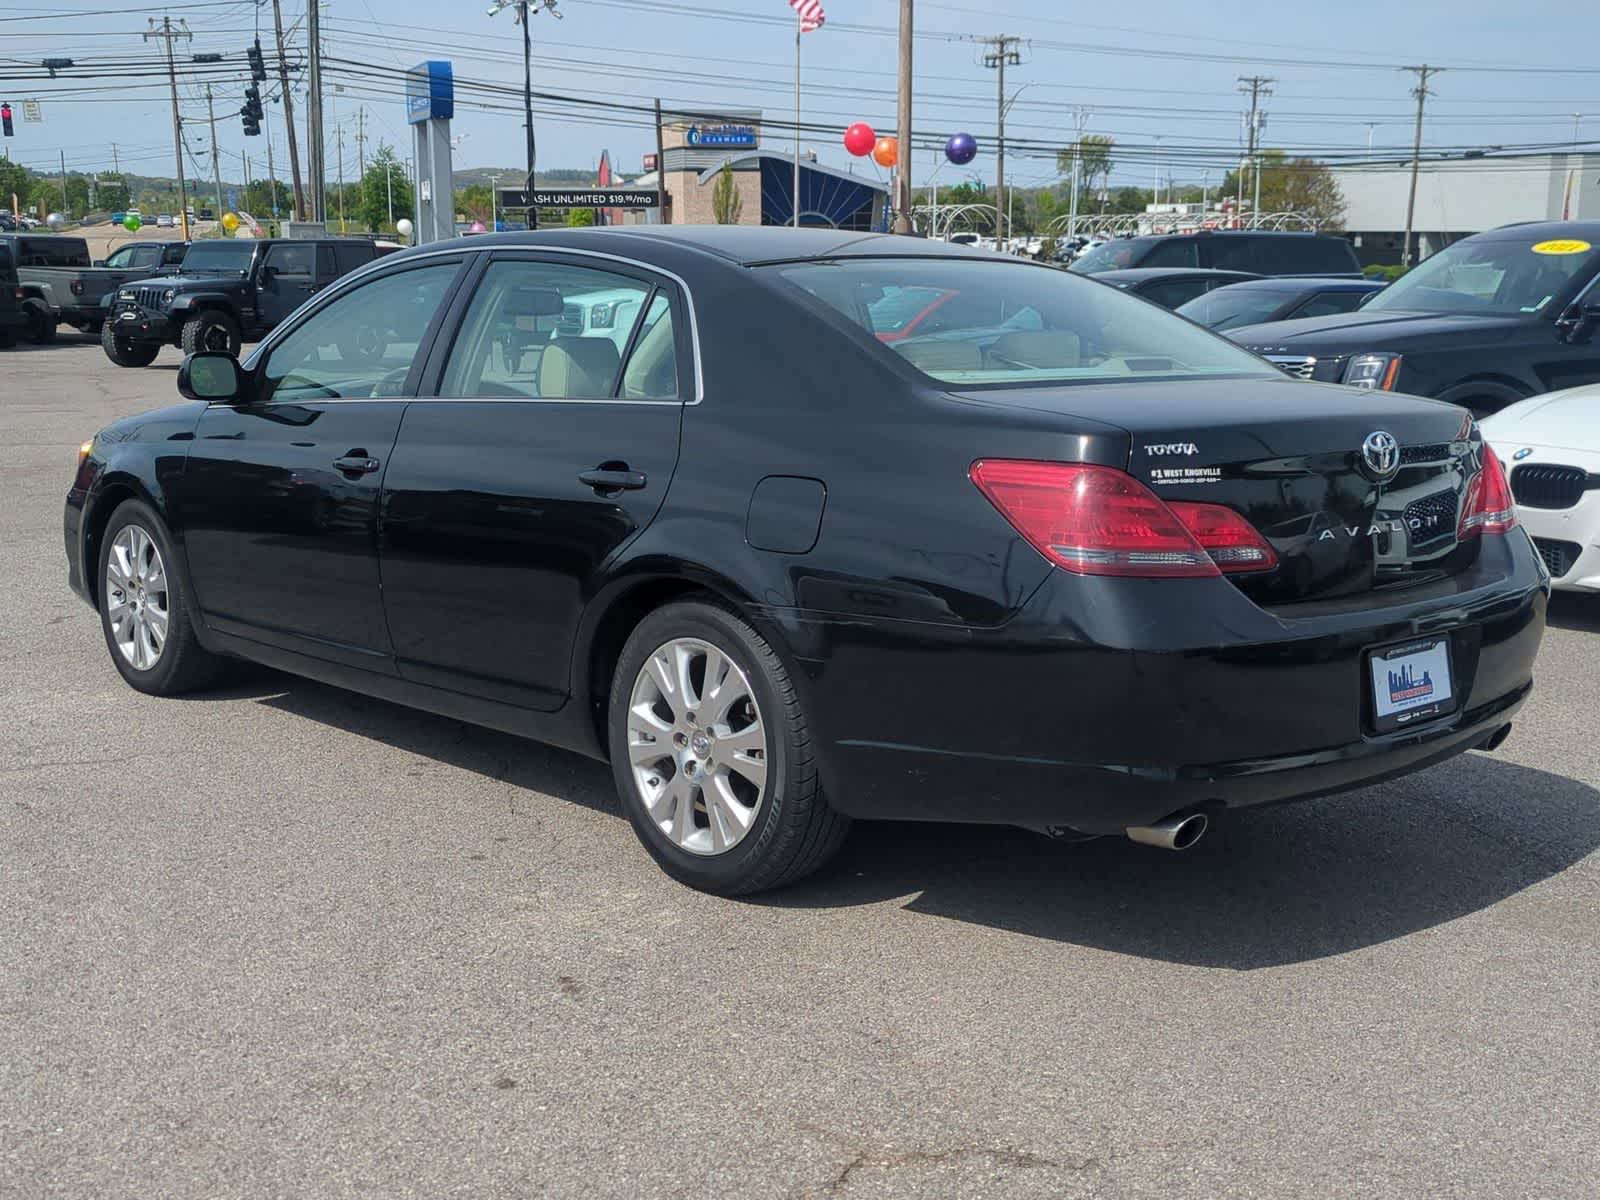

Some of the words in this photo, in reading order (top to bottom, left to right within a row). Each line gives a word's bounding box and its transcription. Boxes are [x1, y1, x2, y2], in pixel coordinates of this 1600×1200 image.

[553, 194, 606, 204] UNLIMITED
[1143, 443, 1199, 456] TOYOTA
[1163, 469, 1183, 478] WEST
